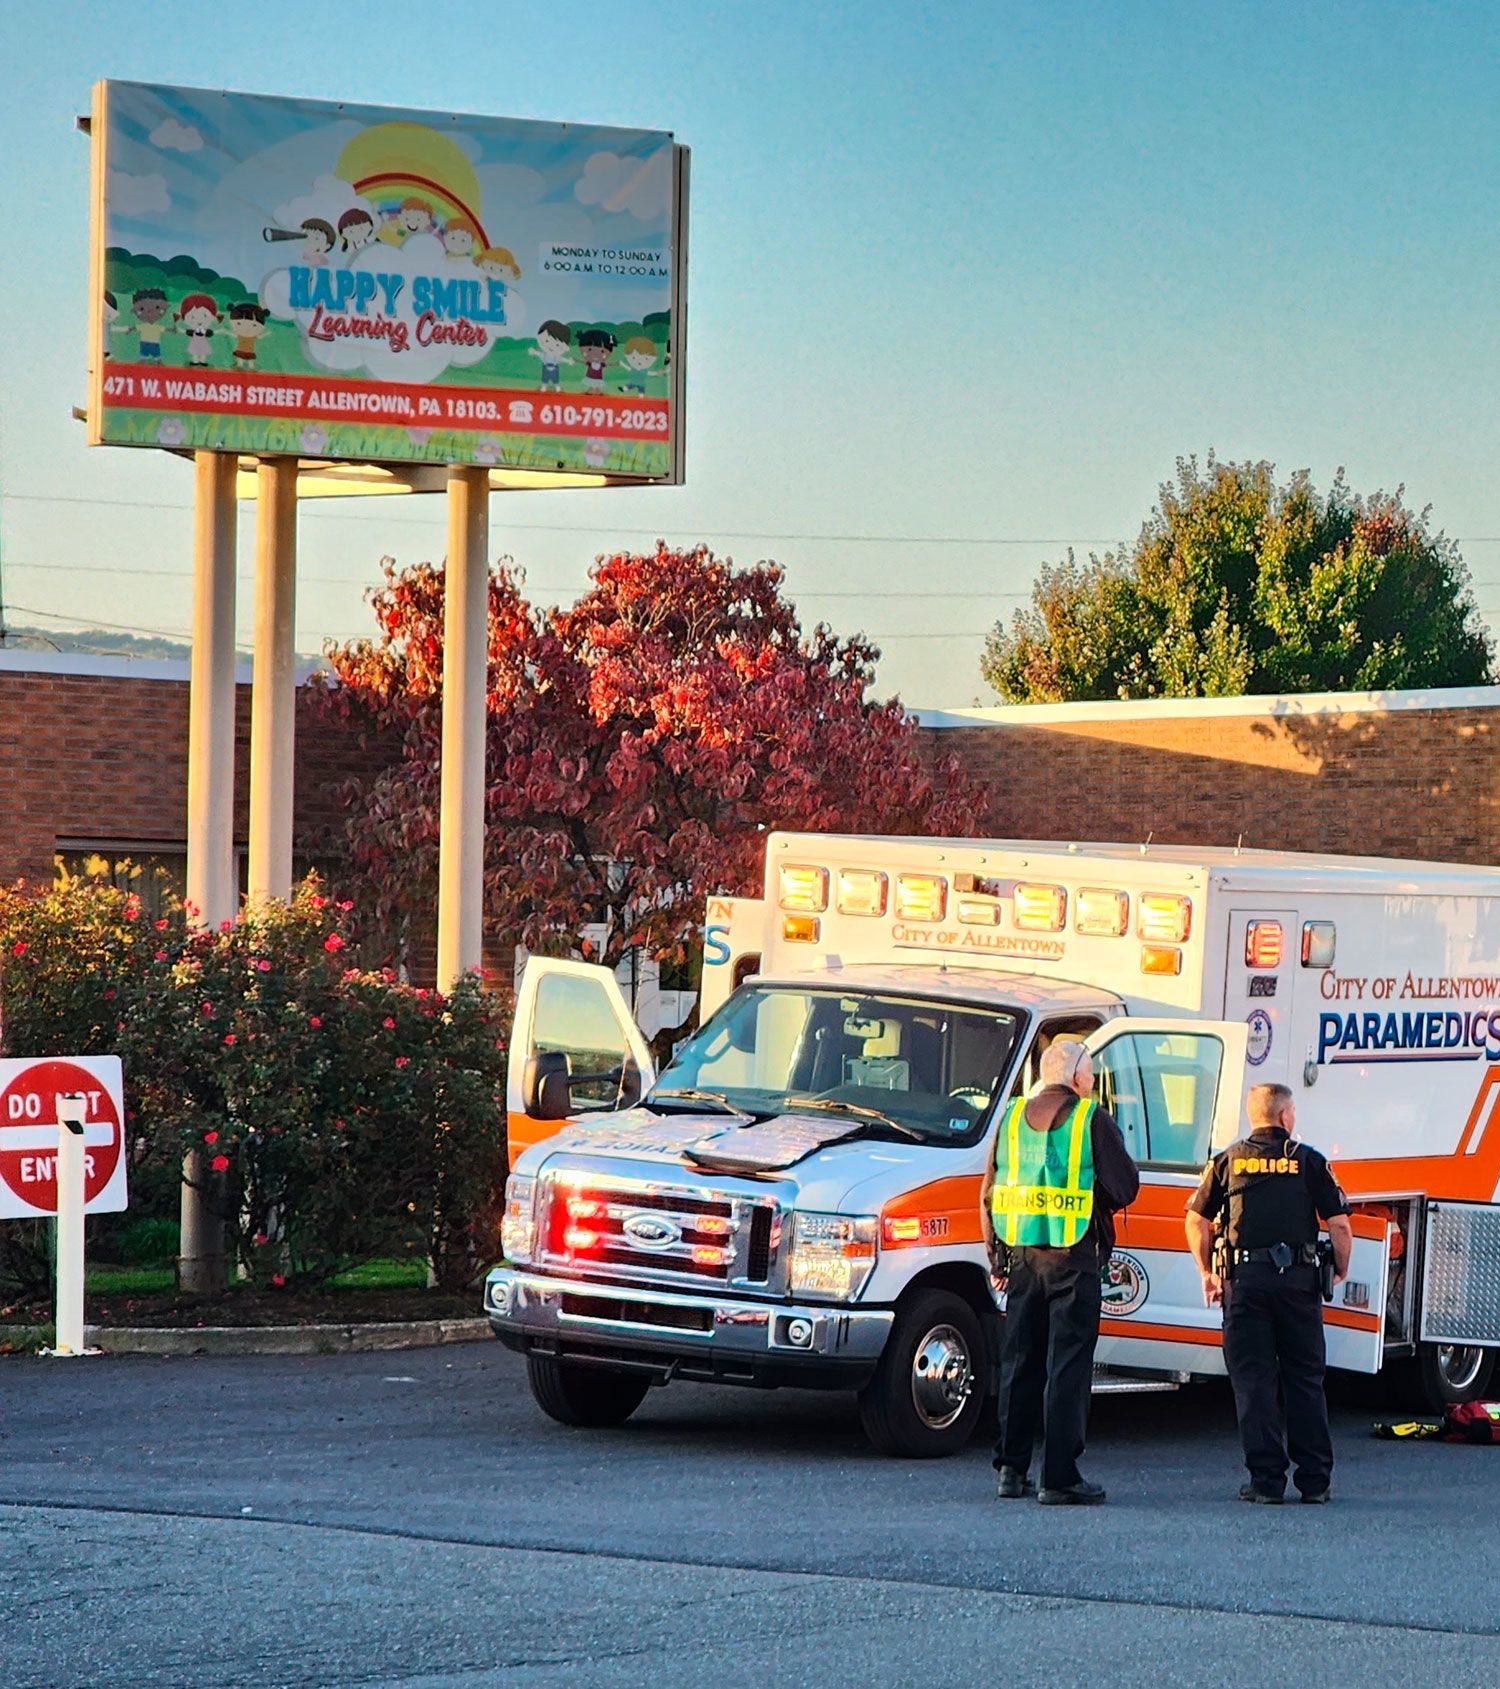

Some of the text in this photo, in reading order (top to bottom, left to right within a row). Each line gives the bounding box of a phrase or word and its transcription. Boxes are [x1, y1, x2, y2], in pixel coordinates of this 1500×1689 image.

[552, 246, 661, 262] MONDAY TO SUNDAY
[598, 264, 611, 274] TO
[288, 265, 508, 325] HAPPY SMILE
[308, 303, 489, 352] Learning Center
[103, 376, 669, 432] 471 W. WABASH STREET ALLENTOWN, PA 18103. 610-791-2023
[891, 923, 1067, 955] CITY OF ALLENTOWN
[1320, 969, 1368, 1000] CITY
[1371, 977, 1398, 1000] OF
[8, 1093, 41, 1119] DO
[20, 1154, 96, 1183] ENTR
[1233, 1157, 1299, 1175] POLICE
[1000, 1191, 1087, 1212] TRANSPORT
[923, 1217, 948, 1236] 5877
